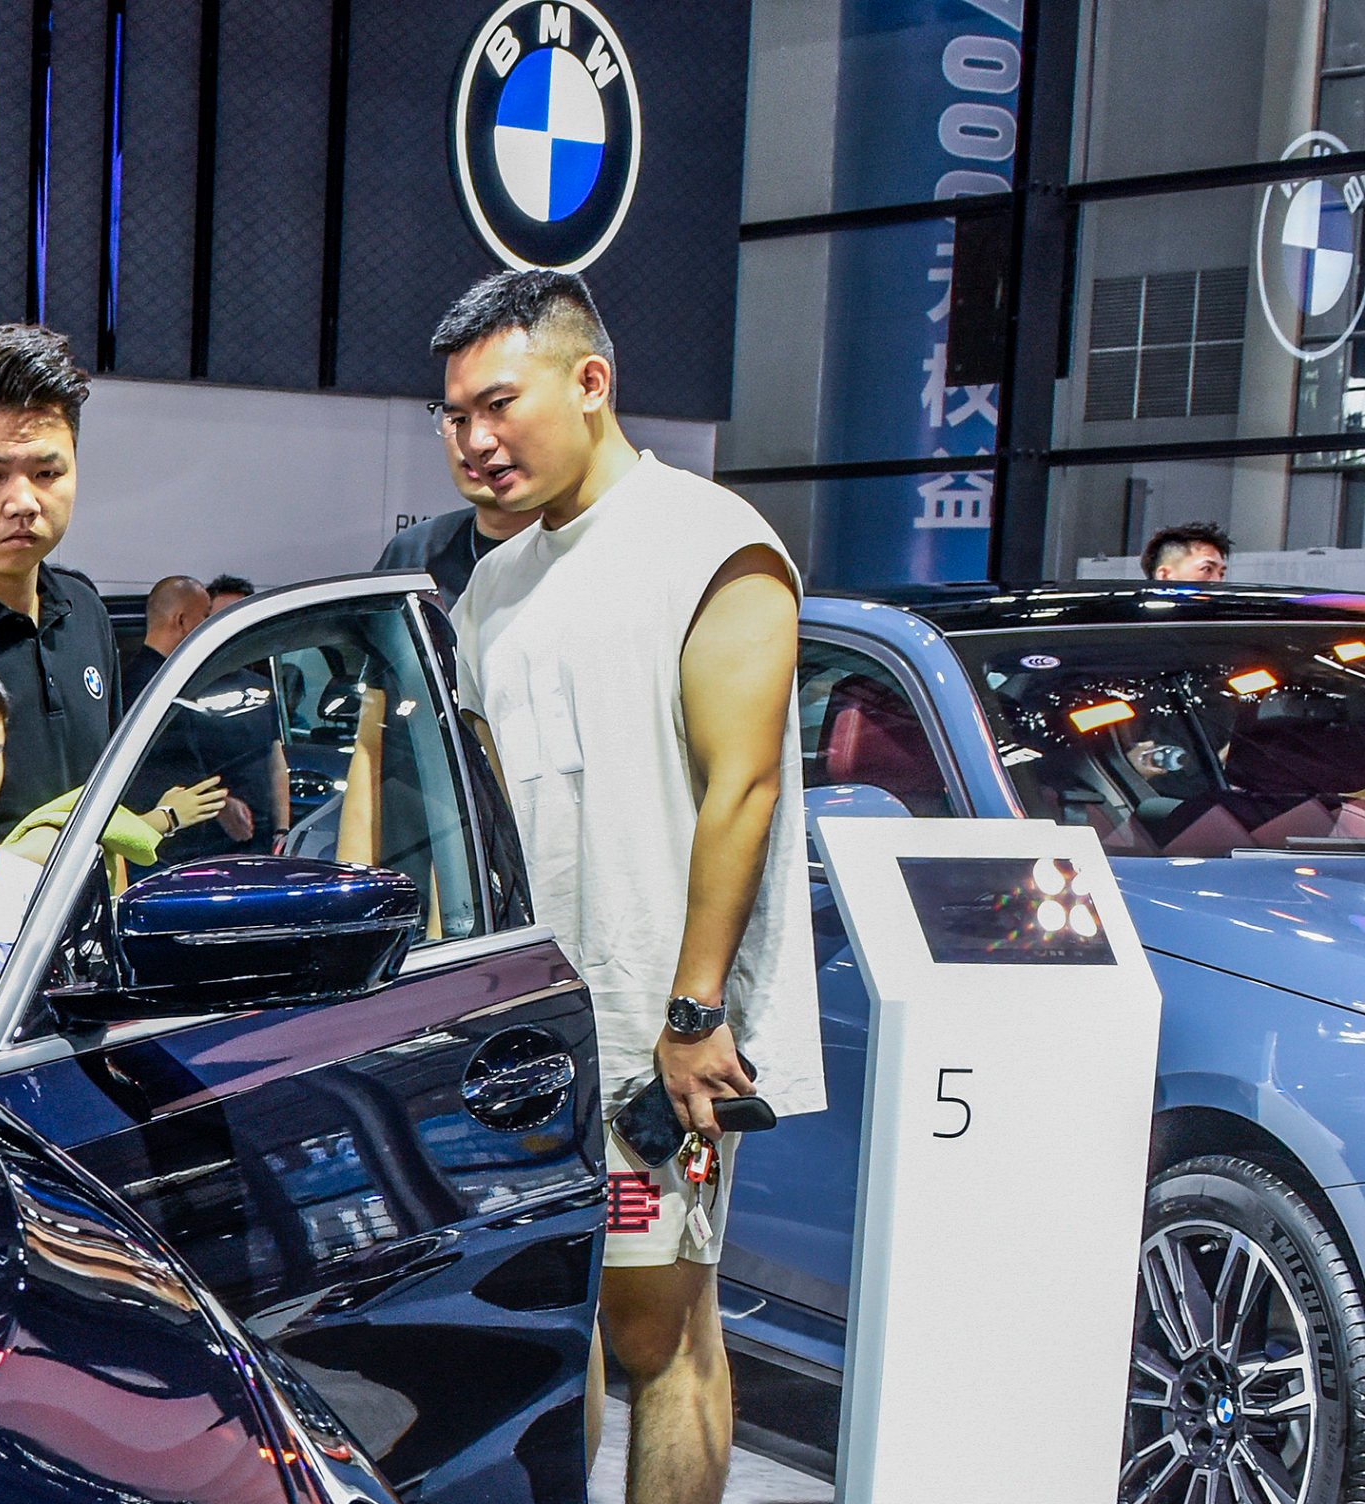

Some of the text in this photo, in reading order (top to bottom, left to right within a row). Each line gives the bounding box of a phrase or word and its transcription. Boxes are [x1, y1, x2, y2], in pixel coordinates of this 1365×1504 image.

[485, 3, 620, 89] BMW
[931, 1067, 974, 1139] 5
[1275, 1235, 1338, 1392] MICHELIN
